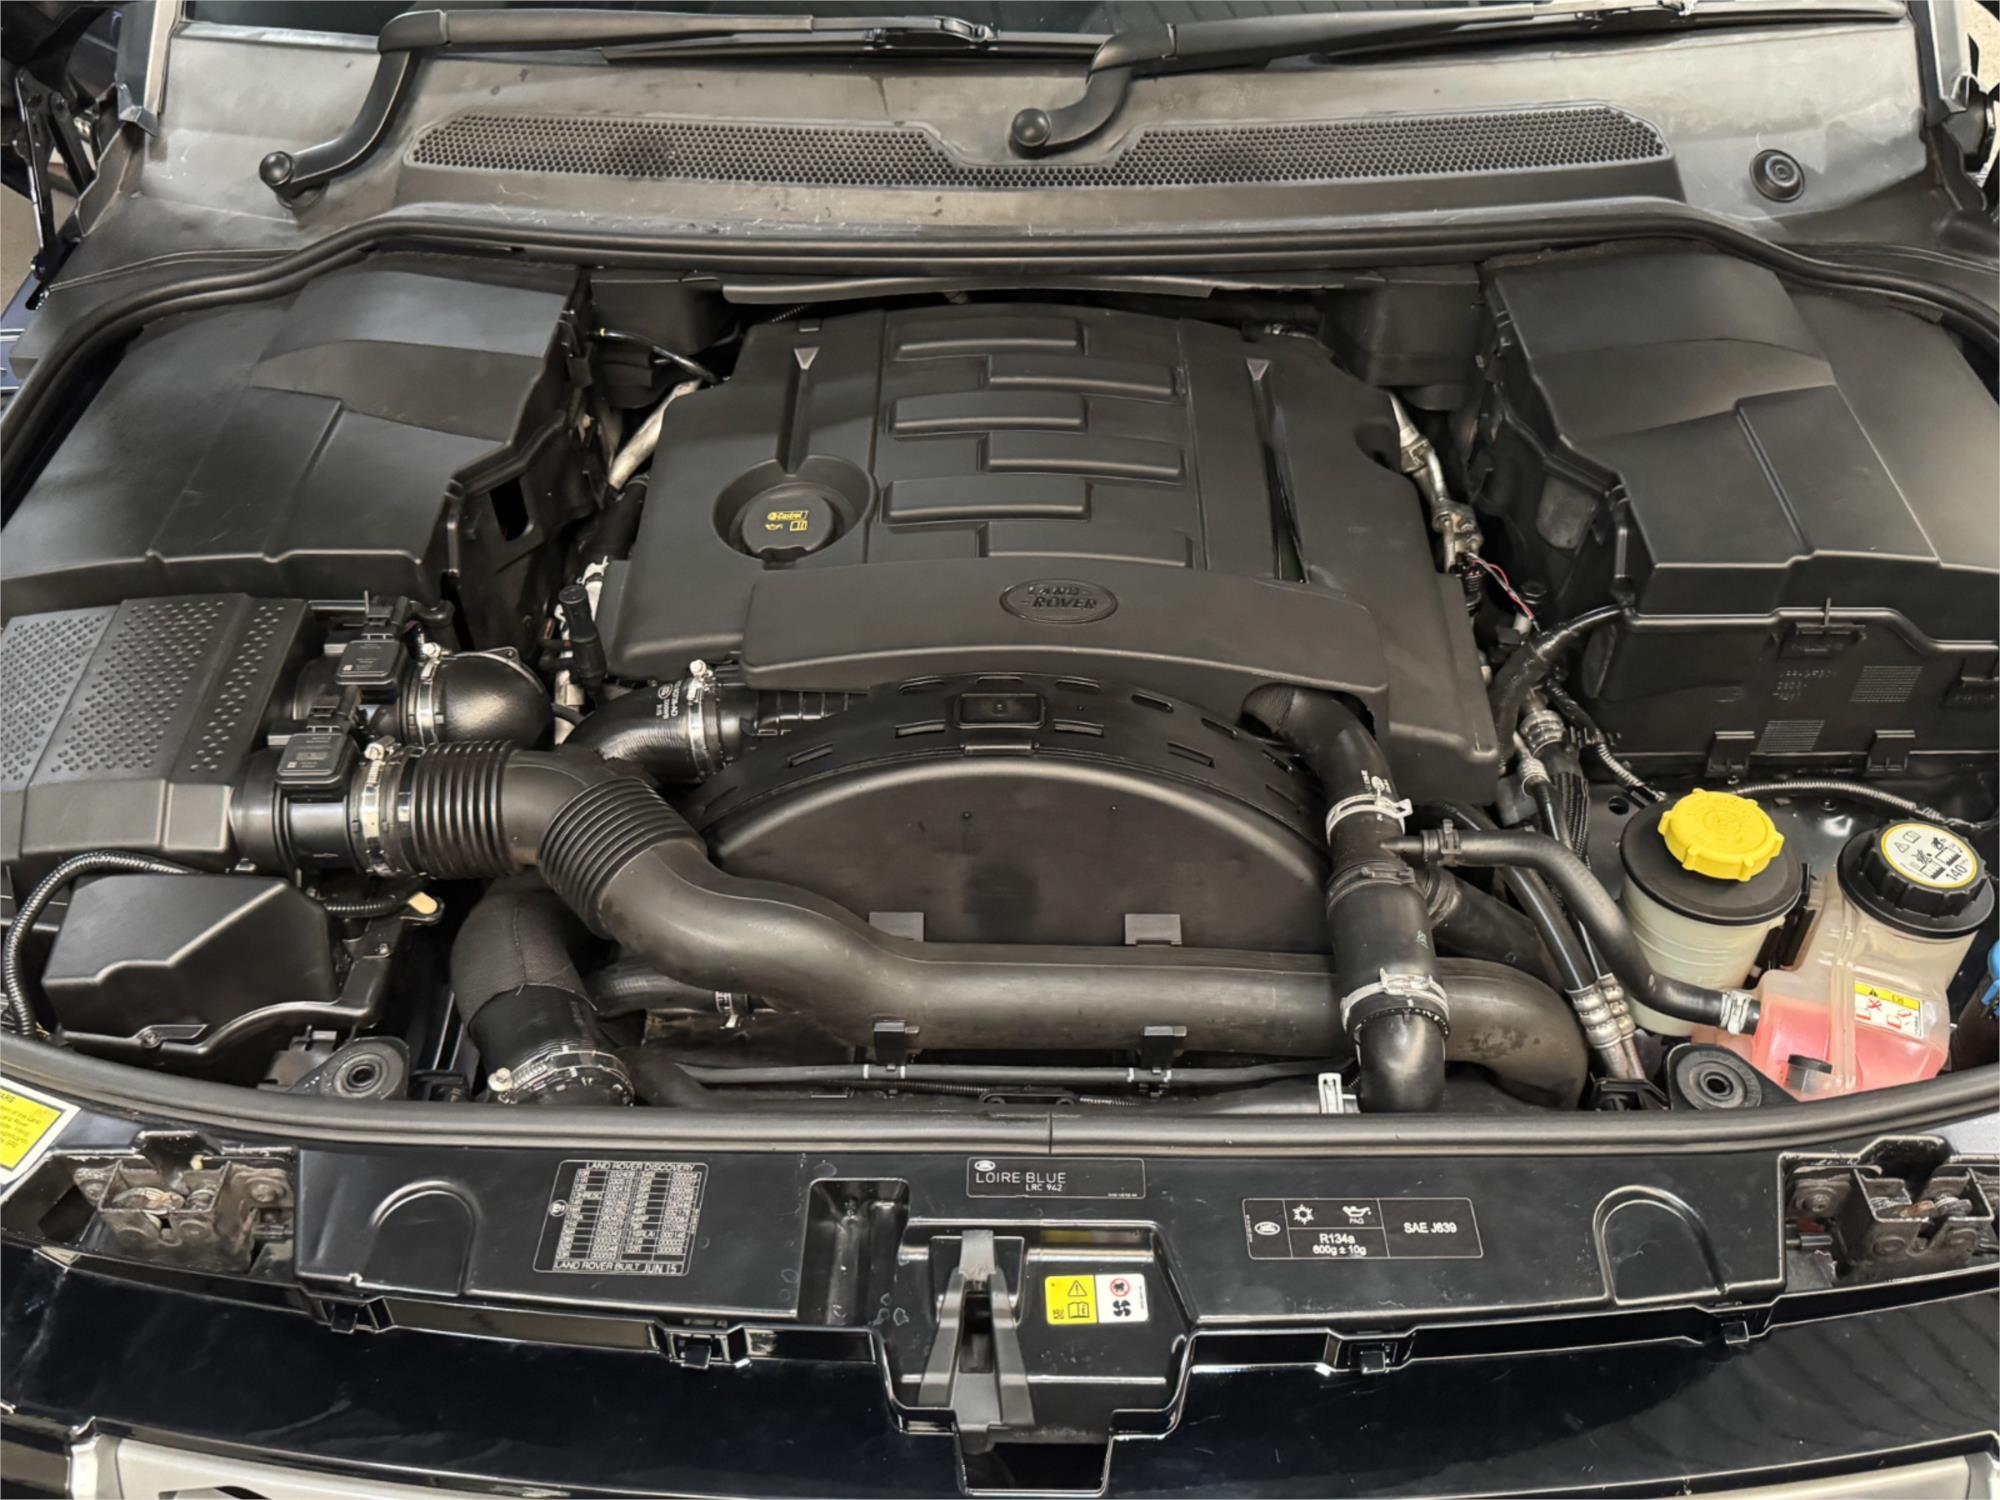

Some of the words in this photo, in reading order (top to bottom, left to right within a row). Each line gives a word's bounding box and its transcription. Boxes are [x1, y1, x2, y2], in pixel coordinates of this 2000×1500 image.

[1028, 585, 1080, 596] LAND
[1032, 597, 1097, 609] ROVER
[1945, 864, 1967, 881] 140
[586, 1161, 610, 1170] LAND
[612, 1162, 643, 1171] ROVER
[644, 1163, 695, 1172] DISCOVERY
[975, 1172, 1021, 1184] LOIRE
[1025, 1172, 1067, 1184] BLUE
[1025, 1184, 1043, 1192] LRC
[1046, 1184, 1063, 1192] 942
[1404, 1222, 1429, 1233] SAE
[1431, 1222, 1458, 1233] J639
[1319, 1233, 1355, 1245] R134a
[1348, 1245, 1367, 1256] 10g
[554, 1261, 579, 1270] LAND
[582, 1261, 613, 1271] ROVER
[614, 1262, 640, 1271] BUILT
[641, 1263, 664, 1274] JUN
[666, 1263, 678, 1274] 15
